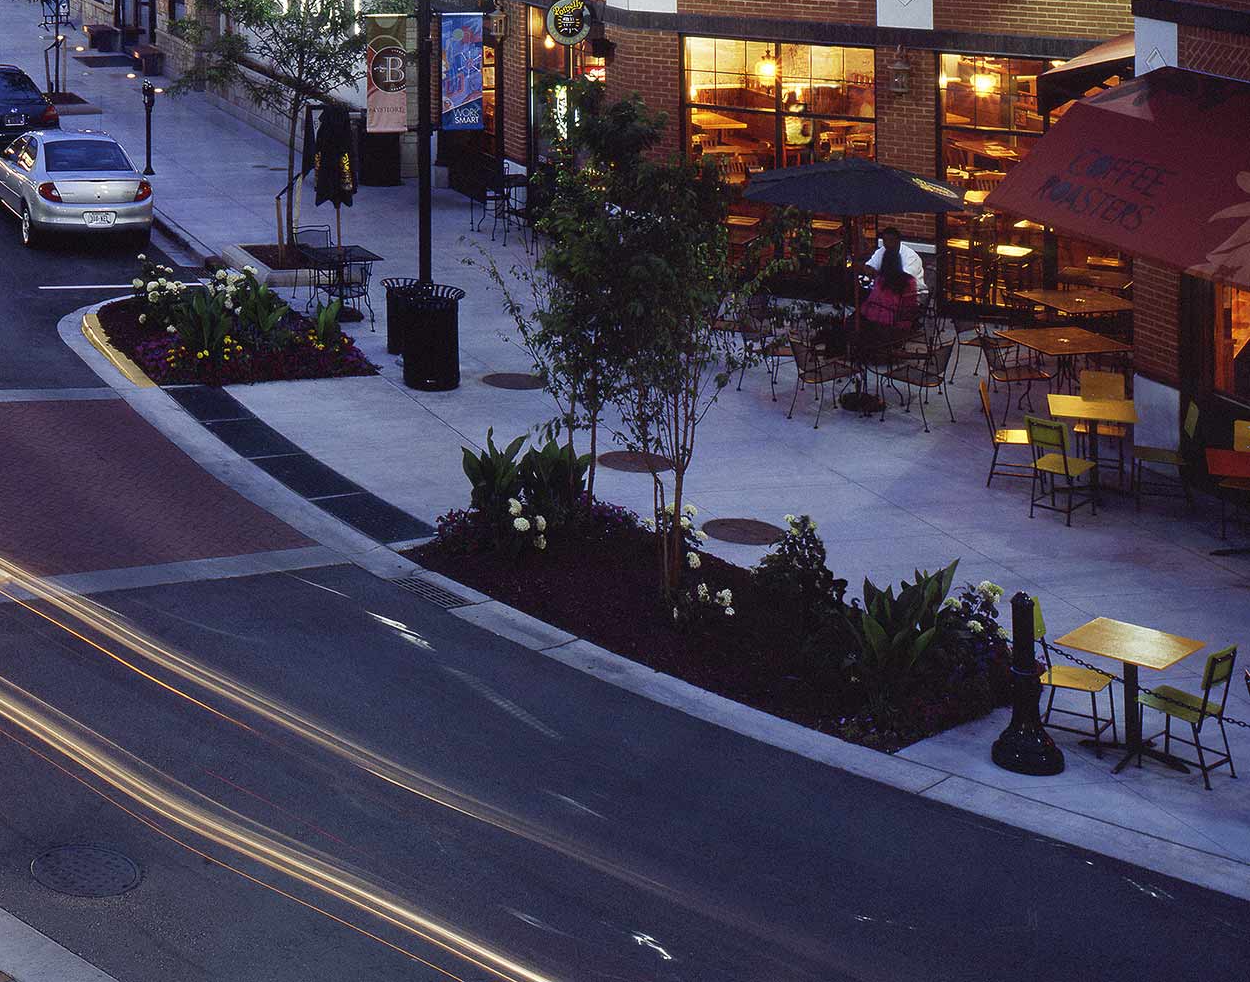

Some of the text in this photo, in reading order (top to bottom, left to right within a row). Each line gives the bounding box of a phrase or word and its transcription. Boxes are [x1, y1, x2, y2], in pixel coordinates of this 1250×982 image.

[553, 0, 584, 16] Potbelly
[382, 56, 406, 83] B
[453, 107, 480, 117] WORK
[455, 116, 480, 124] SMART
[1067, 149, 1174, 198] COFFEE
[1036, 176, 1155, 233] ROASTERS
